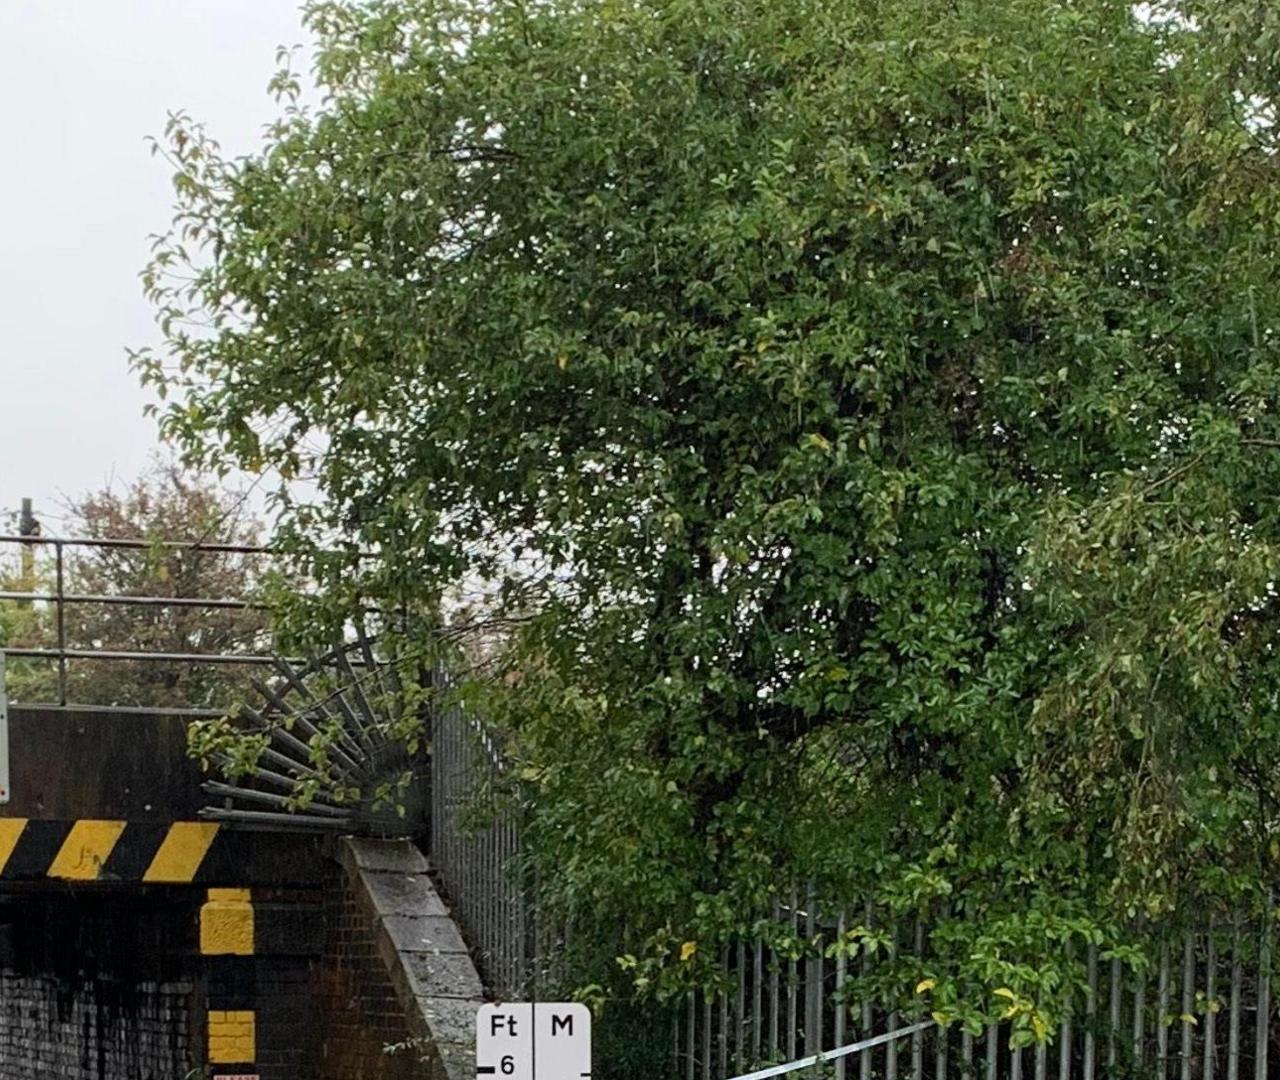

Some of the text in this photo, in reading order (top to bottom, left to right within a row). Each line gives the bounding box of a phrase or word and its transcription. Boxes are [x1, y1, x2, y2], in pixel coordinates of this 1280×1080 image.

[490, 1014, 518, 1037] Ft
[551, 1015, 574, 1036] M
[500, 1055, 515, 1075] 6
